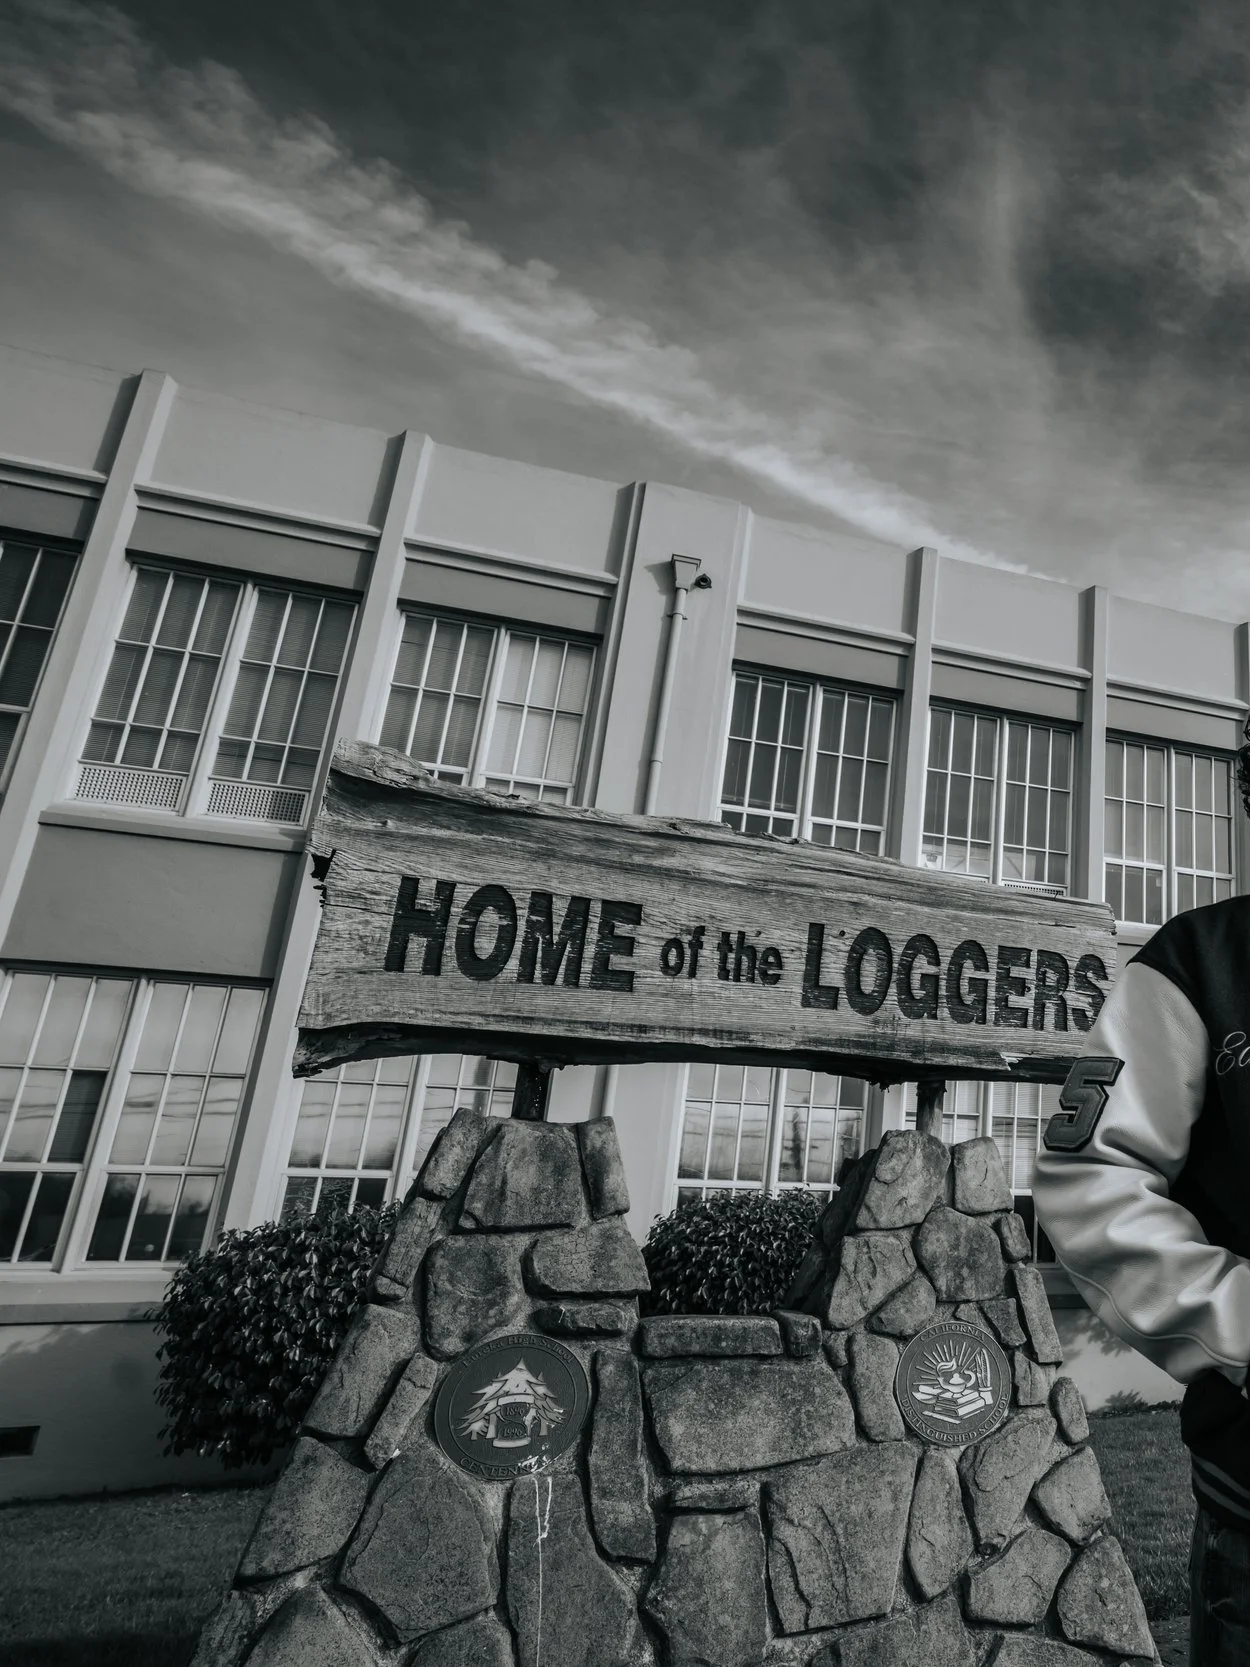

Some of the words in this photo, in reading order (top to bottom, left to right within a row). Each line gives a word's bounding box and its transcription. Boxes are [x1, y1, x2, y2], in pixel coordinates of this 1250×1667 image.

[384, 876, 643, 992] HOME
[659, 925, 706, 979] of
[717, 930, 784, 985] the
[801, 922, 1108, 1032] LOGGERS
[1043, 1056, 1125, 1153] 5
[508, 1335, 538, 1347] High
[541, 1339, 577, 1364] School
[919, 1323, 986, 1342] CALIFORNIA
[901, 1398, 977, 1443] DISTINGUISHED
[978, 1393, 1009, 1434] SCHOOL
